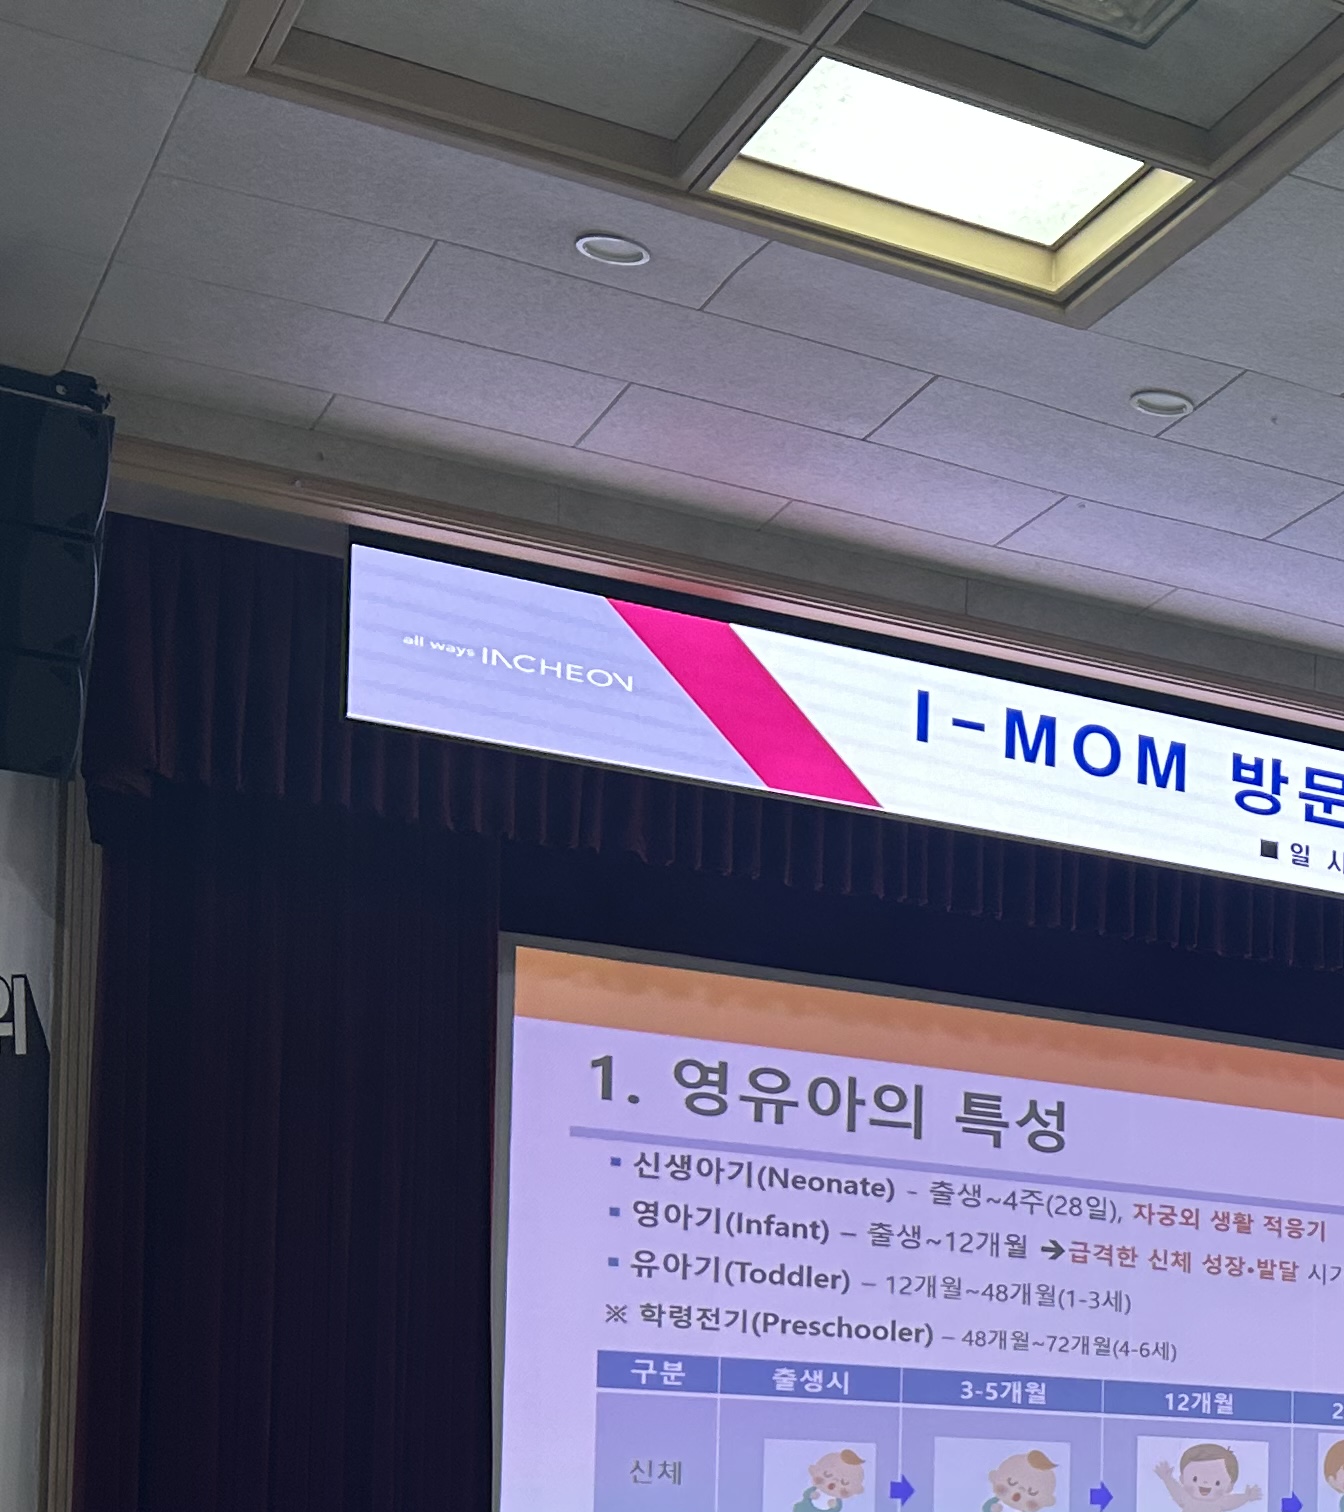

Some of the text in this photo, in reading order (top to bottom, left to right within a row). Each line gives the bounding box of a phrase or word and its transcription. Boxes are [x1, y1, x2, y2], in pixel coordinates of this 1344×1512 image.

[402, 633, 635, 693] all ways INCHEON
[915, 689, 1188, 793] I-MOM
[1290, 842, 1311, 868] 일
[589, 1054, 1067, 1154] 1. 영유아의 특성
[632, 1150, 896, 1202] 신생아기(Neonate)
[928, 1180, 1124, 1224] 출생~4주(28일),
[1133, 1202, 1201, 1231] 자궁외
[1210, 1209, 1255, 1235] 생활
[1262, 1214, 1328, 1243] 적응기
[632, 1199, 831, 1245] 영아기(Infant)
[866, 1221, 1029, 1260] 출생~12개월
[1067, 1239, 1139, 1270] 급격한
[1147, 1247, 1192, 1274] 신체
[629, 1248, 852, 1296] 유아기(Toddler)
[885, 1274, 1133, 1316] 12개월~48개월(1-3세)
[639, 1301, 935, 1348] 학령전기(Preschooler)
[961, 1327, 1178, 1362] 48개월~72개월(4-6세)
[630, 1358, 687, 1386] 구분
[771, 1366, 851, 1396] 출생시
[959, 1380, 1048, 1406] 3-5개월
[1164, 1392, 1236, 1416] 12개월
[629, 1458, 684, 1487] 신체
